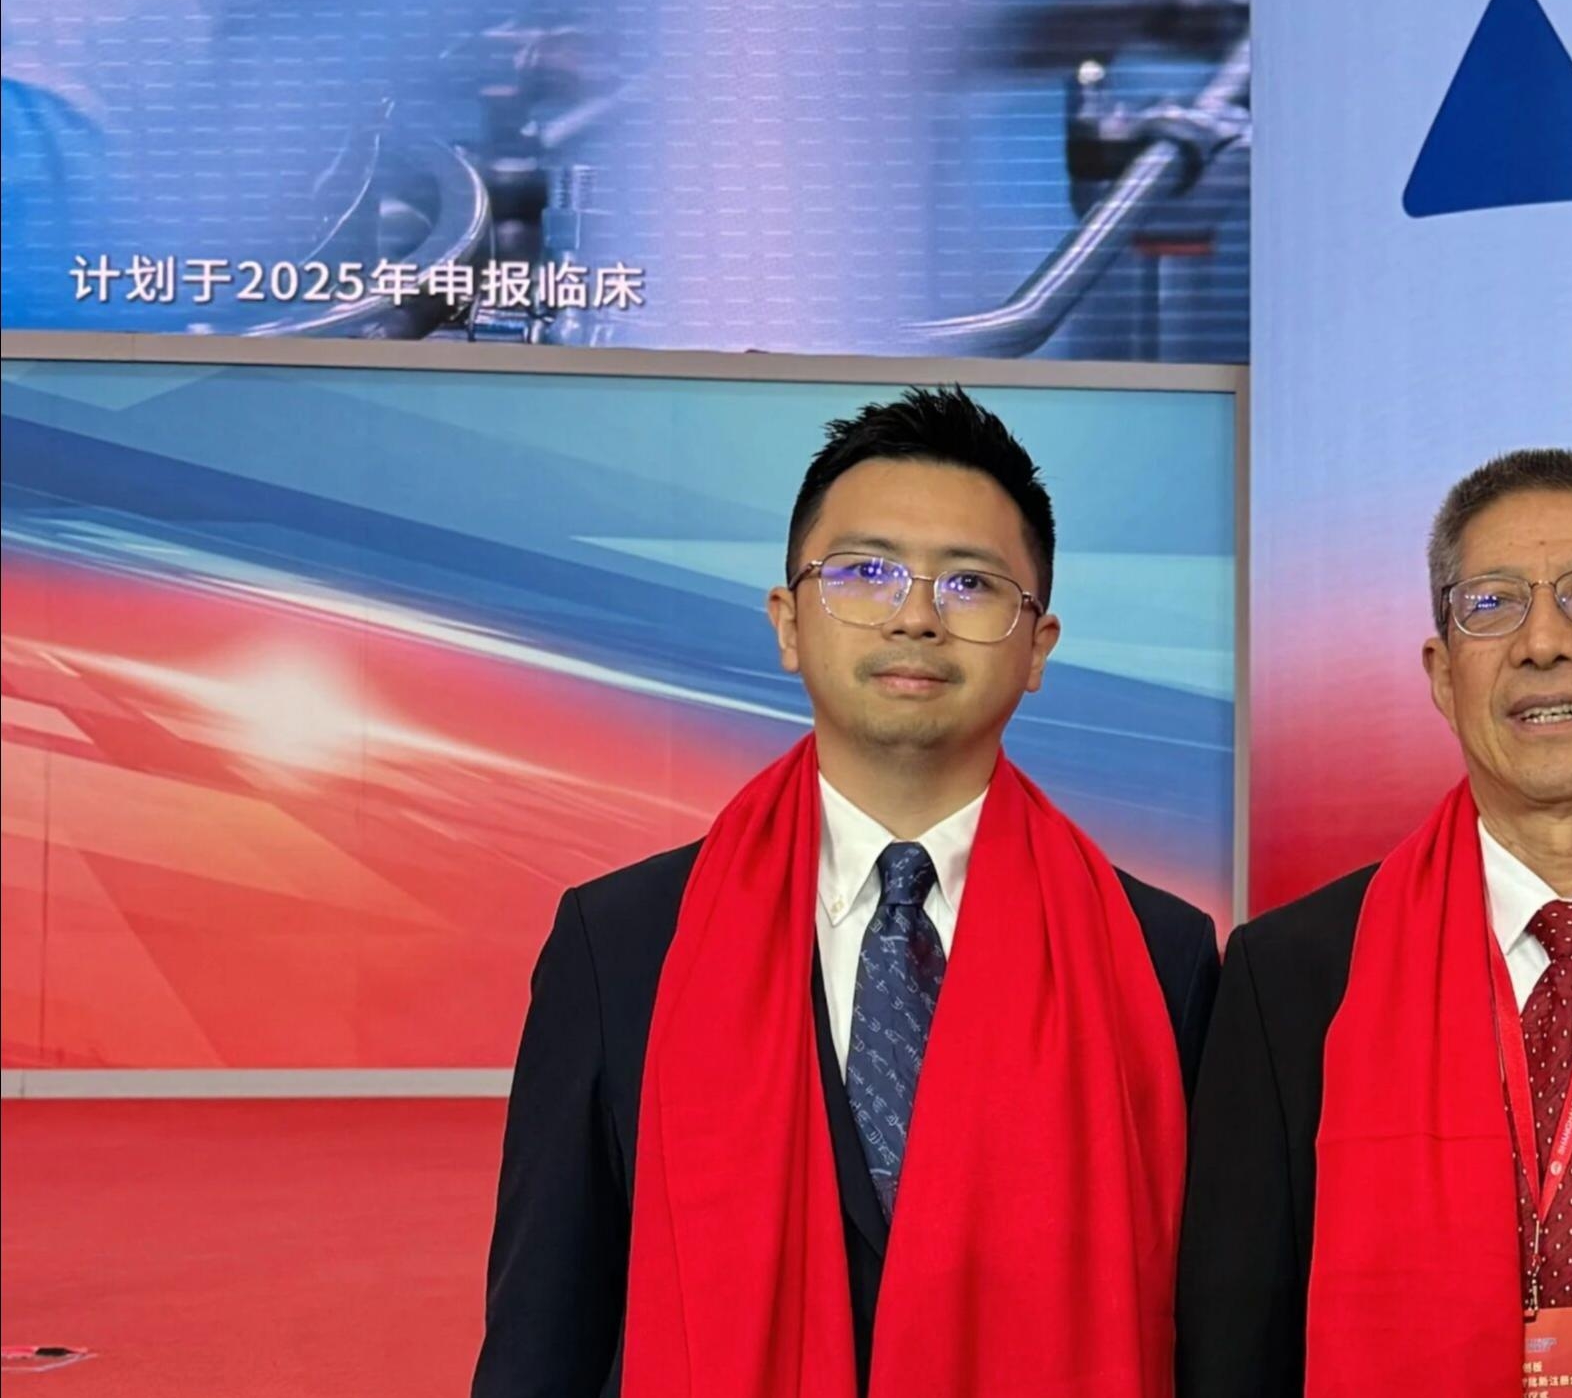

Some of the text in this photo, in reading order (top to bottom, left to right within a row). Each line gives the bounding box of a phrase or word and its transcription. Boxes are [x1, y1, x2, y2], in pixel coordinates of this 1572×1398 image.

[69, 254, 645, 309] 计划于2025年申报临床
